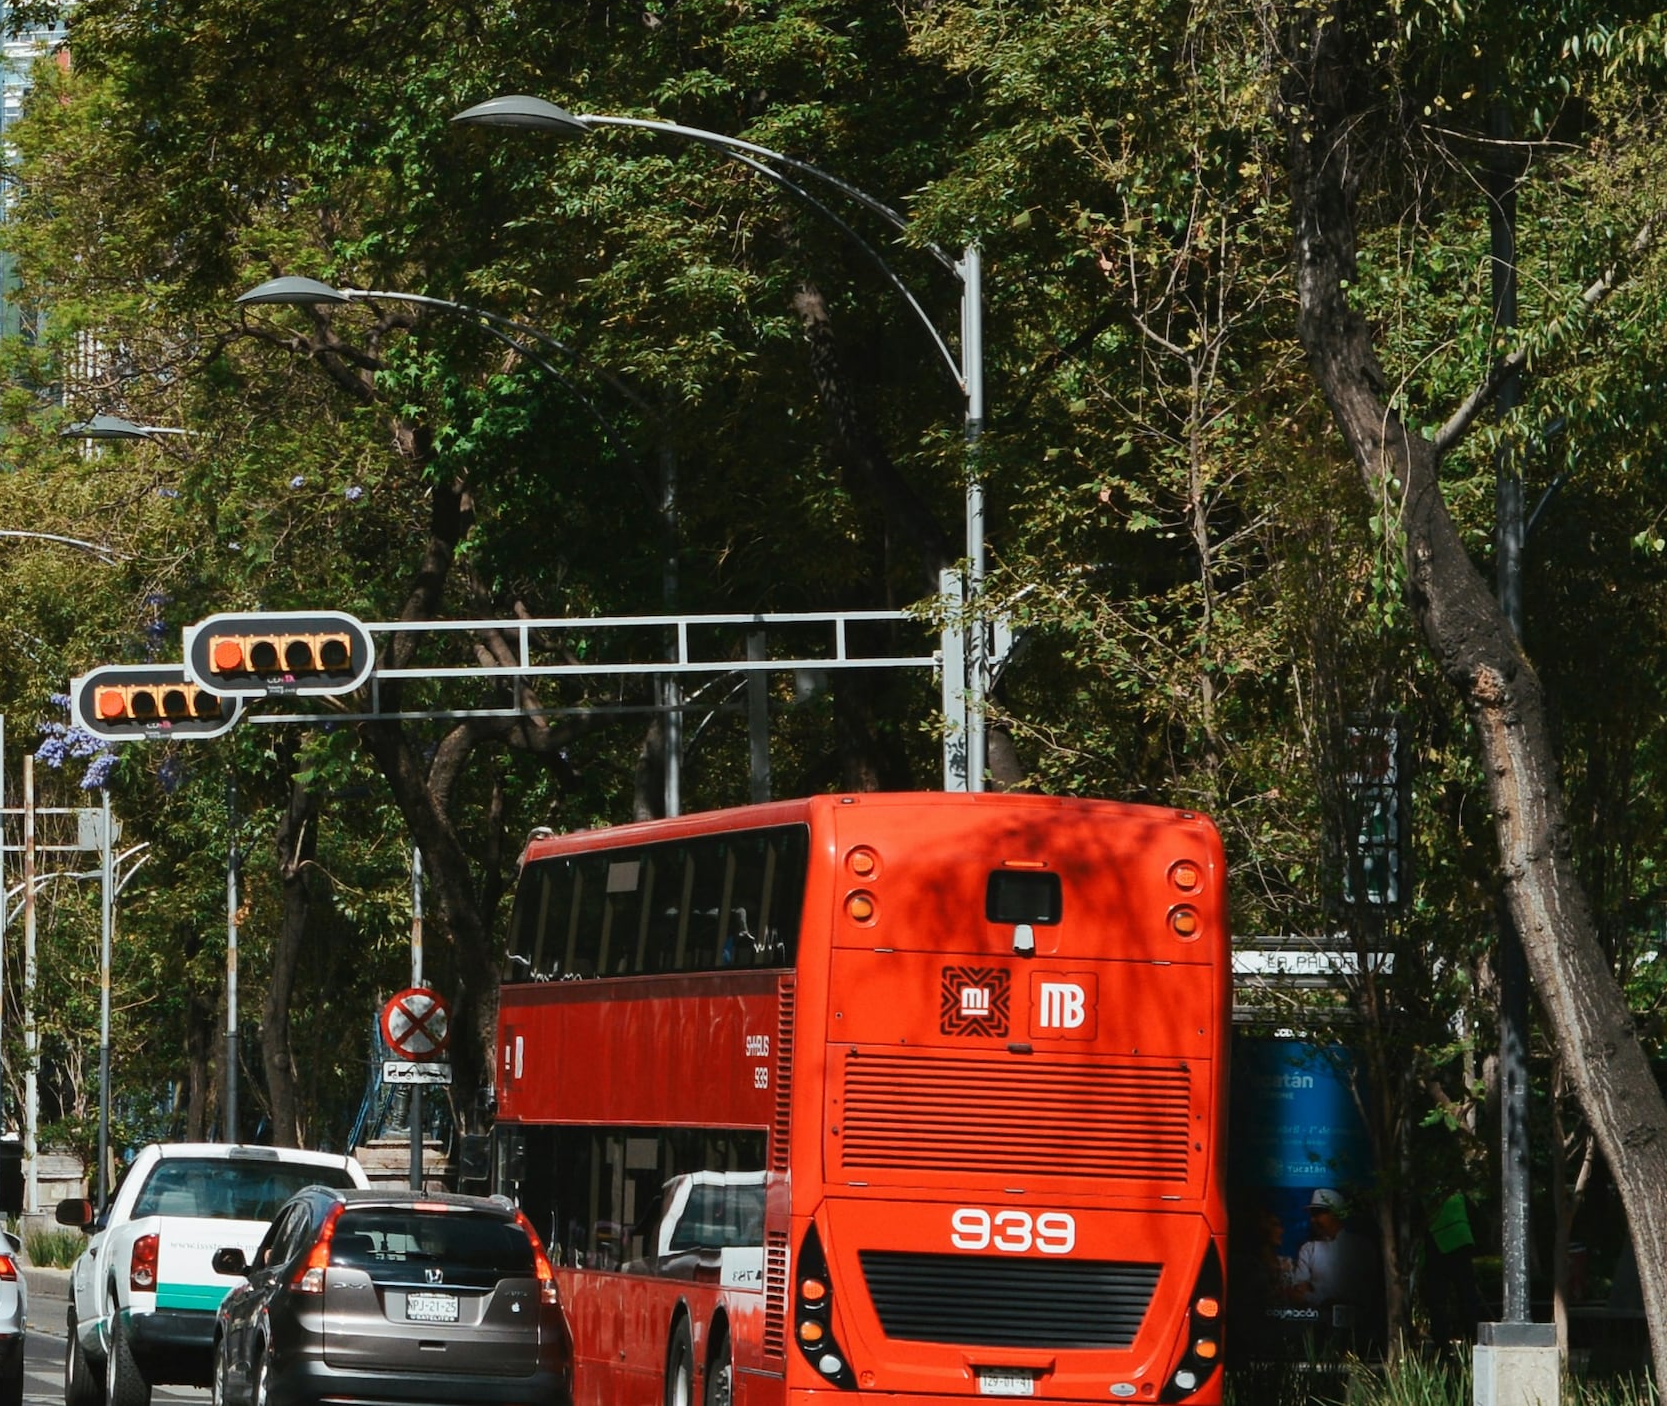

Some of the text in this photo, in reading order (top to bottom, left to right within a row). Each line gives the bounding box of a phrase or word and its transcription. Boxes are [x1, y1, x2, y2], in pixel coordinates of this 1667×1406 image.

[1040, 983, 1085, 1028] MB
[754, 1067, 768, 1089] 939
[951, 1208, 1075, 1254] 939
